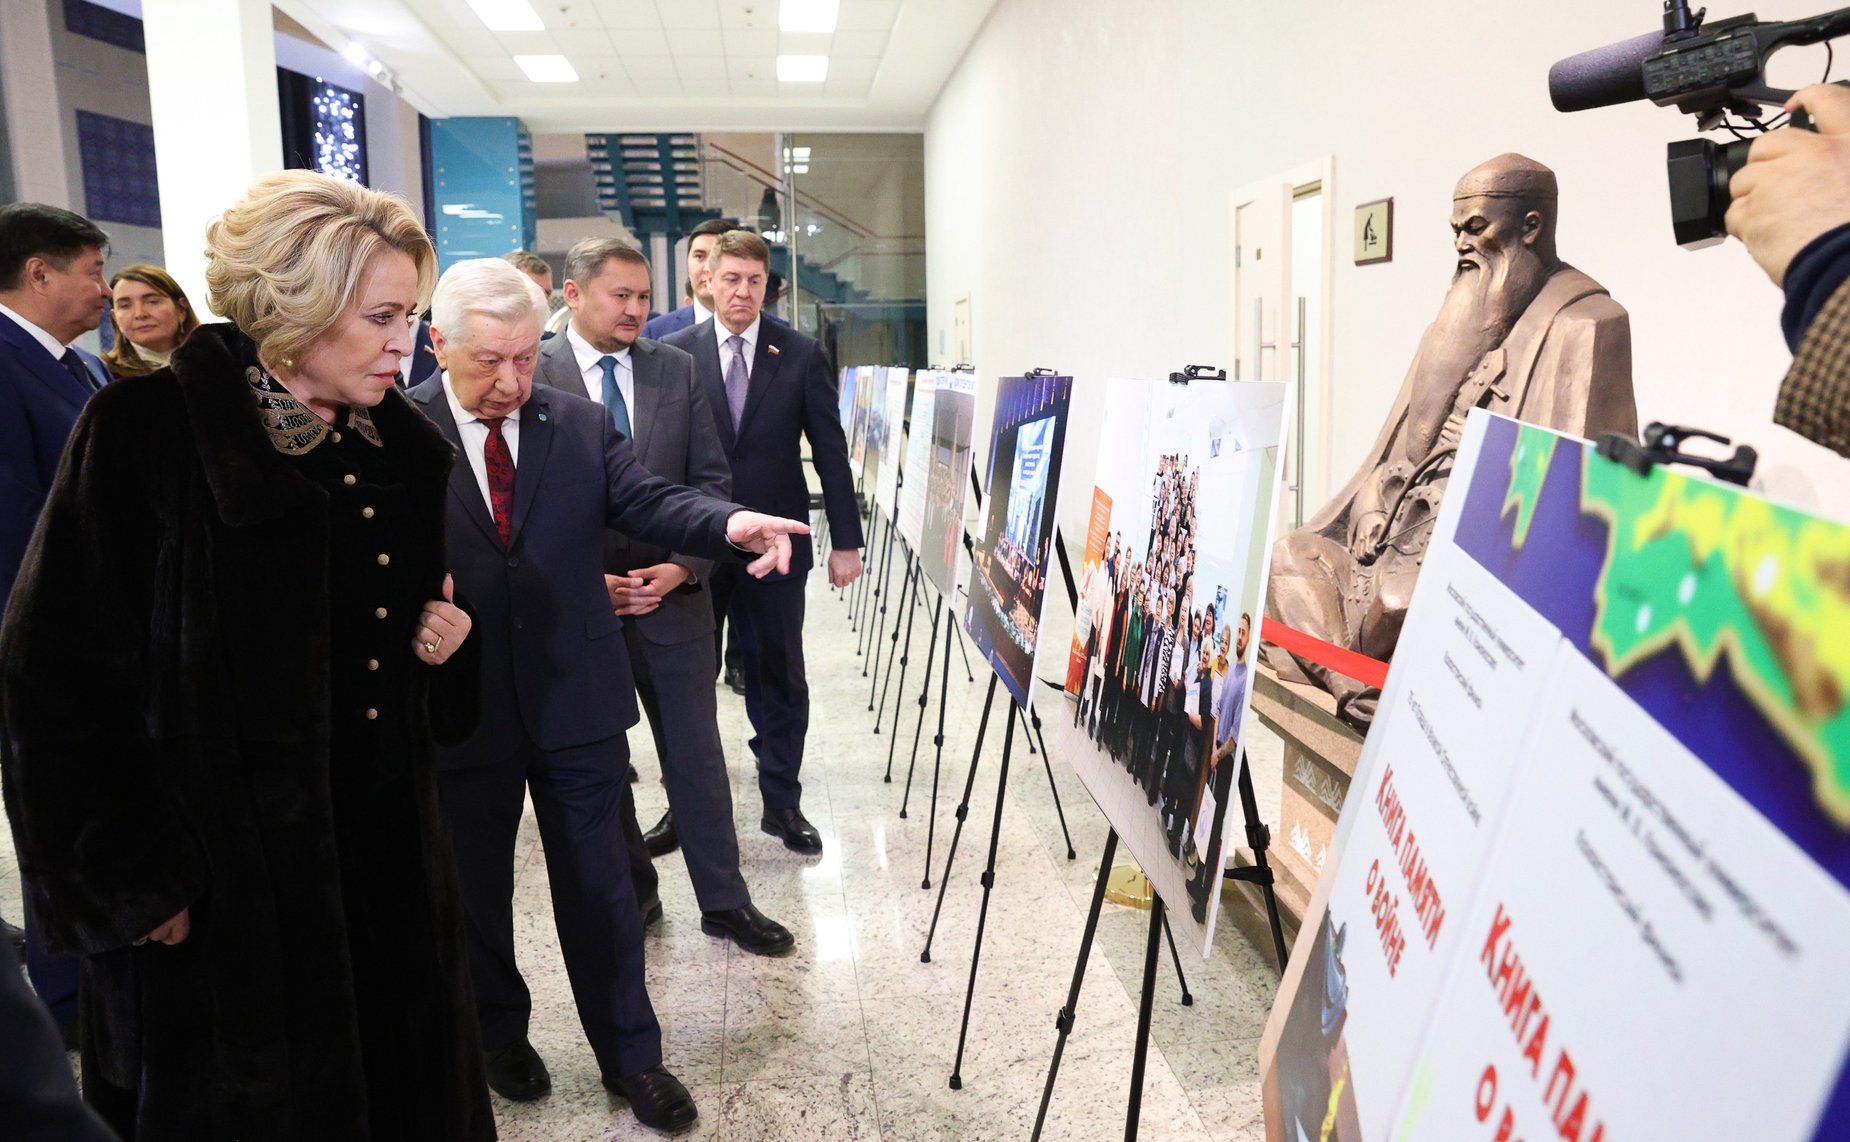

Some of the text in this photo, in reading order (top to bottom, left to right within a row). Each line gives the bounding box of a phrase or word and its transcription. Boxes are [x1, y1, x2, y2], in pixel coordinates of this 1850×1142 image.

[1371, 875, 1406, 978] ВОЙНЕ
[1399, 828, 1446, 952] ПАМЯТИ
[1481, 902, 1606, 1142] КНИГА ПА
